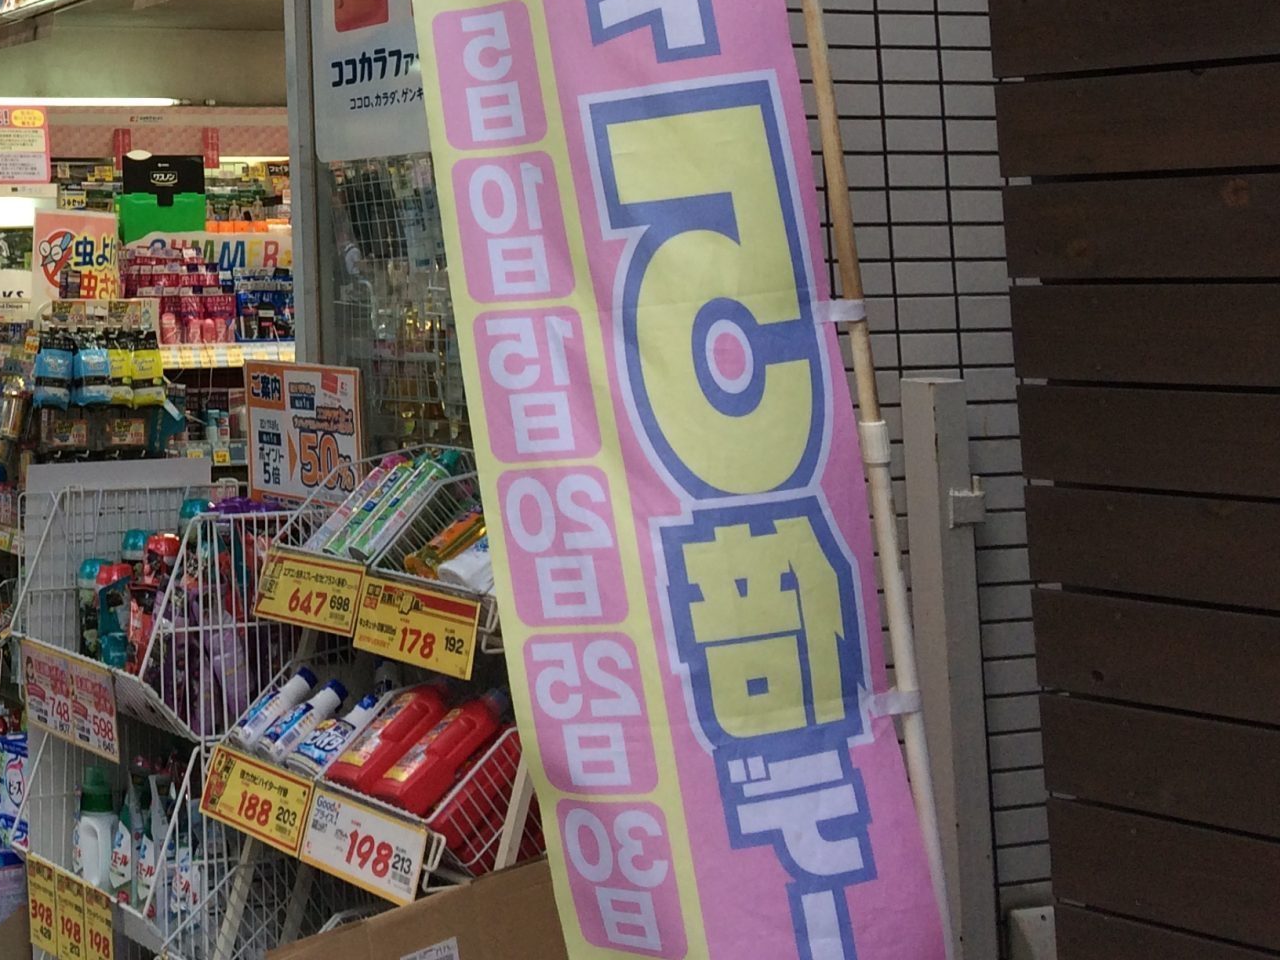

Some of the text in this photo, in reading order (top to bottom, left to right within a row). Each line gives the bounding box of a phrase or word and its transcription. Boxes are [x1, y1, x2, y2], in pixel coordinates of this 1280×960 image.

[331, 47, 420, 88] ココカラファ
[288, 586, 328, 617] 647
[329, 594, 351, 612] 698
[399, 626, 436, 660] 178
[445, 635, 465, 655] 192
[49, 696, 70, 723] 748
[92, 715, 114, 742] 598
[237, 789, 273, 827] 188
[275, 805, 298, 828] 203
[345, 829, 394, 879] 198
[391, 853, 413, 875] 213
[31, 898, 53, 928] 398
[60, 915, 82, 944] 198
[89, 927, 110, 959] 198
